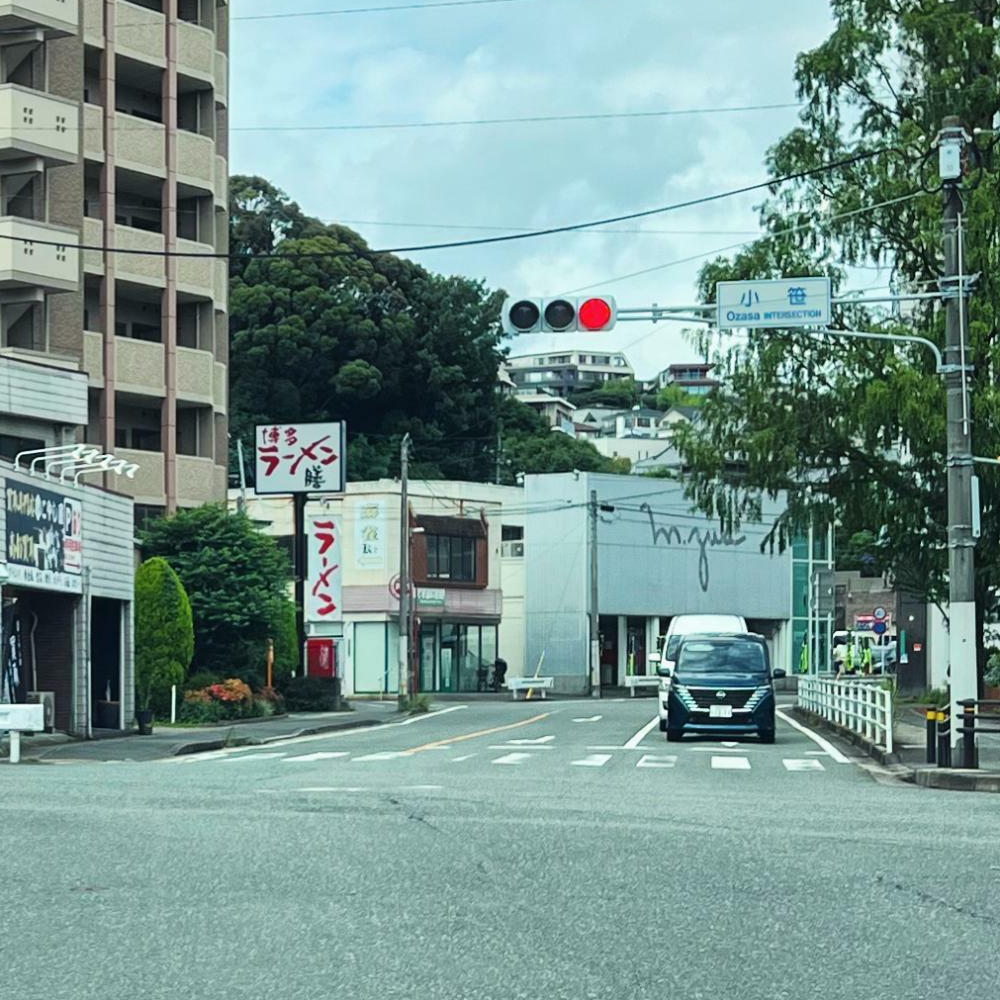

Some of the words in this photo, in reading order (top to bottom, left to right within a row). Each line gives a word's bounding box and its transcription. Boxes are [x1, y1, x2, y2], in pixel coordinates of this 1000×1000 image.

[727, 311, 760, 321] Ozasa
[763, 309, 822, 319] INTERSECTION
[262, 426, 298, 446] 博多
[258, 435, 338, 477] ラーメン
[312, 521, 338, 616] ラーメン
